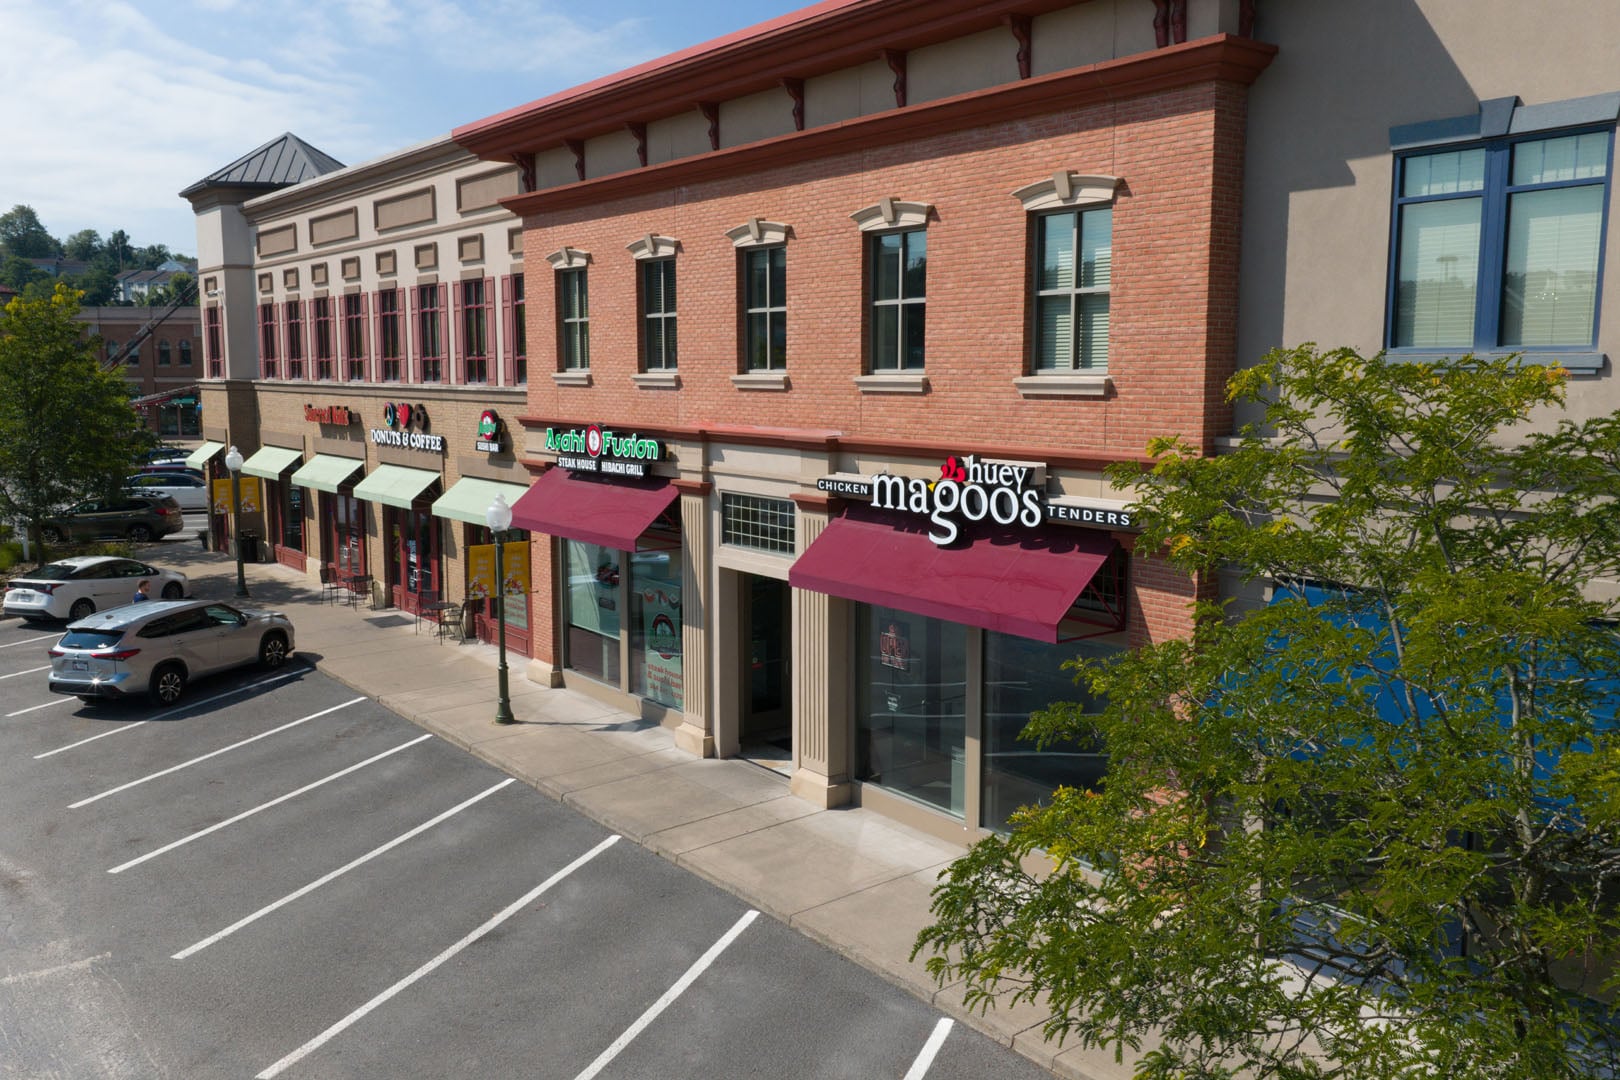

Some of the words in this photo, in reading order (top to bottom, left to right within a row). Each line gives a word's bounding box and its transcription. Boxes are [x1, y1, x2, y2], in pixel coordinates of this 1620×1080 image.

[370, 429, 401, 446] DONUTS
[402, 432, 409, 446] &
[410, 433, 442, 451] COFFEE
[545, 428, 585, 453] Asahi
[602, 431, 659, 460] Fusion
[558, 457, 576, 468] STEAK
[577, 459, 597, 471] HOUSE
[601, 461, 626, 475] HIBACHI
[626, 464, 644, 476] GRILL
[968, 454, 1028, 495] huey
[818, 480, 868, 495] CHICKEN
[1048, 505, 1130, 526] TENDERS
